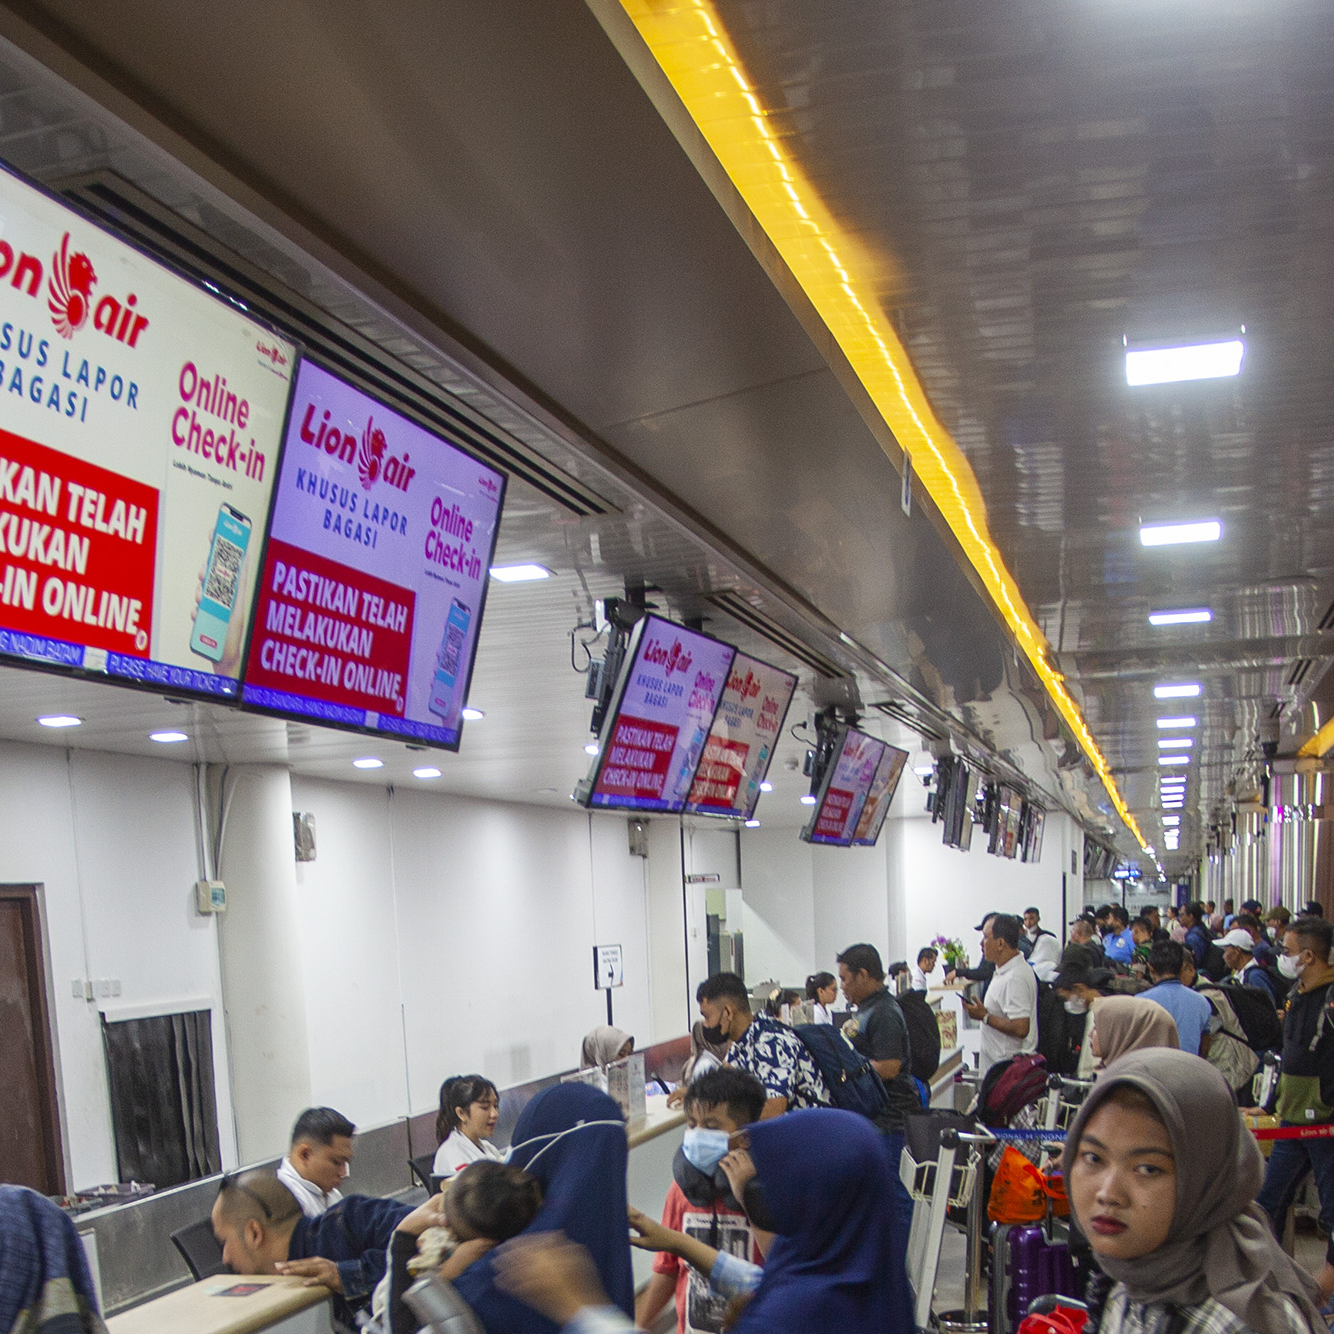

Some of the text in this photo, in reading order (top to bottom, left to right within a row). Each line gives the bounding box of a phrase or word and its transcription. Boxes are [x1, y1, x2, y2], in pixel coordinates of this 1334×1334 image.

[93, 294, 149, 348] air
[61, 350, 139, 411] LAPOR
[179, 361, 250, 429] Online
[171, 406, 265, 483] Check-in
[299, 404, 416, 494] Lion air
[67, 482, 147, 545] TELAH
[296, 468, 409, 538] KHUSUS LAPOR
[323, 509, 378, 550] BAGASI
[430, 495, 473, 542] Online
[424, 531, 481, 581] Check-in
[43, 577, 142, 634] ONLINE
[272, 560, 409, 635] PASTIKAN TELAH
[266, 603, 373, 659] MELAKUKAN
[643, 639, 693, 673] Lion air
[260, 640, 402, 702] CHECK-IN ONLINE
[636, 674, 685, 697] KHUSUS LAPOR
[609, 747, 656, 769] MELAKUKAN
[615, 725, 675, 752] PASTIKAN TELAH
[602, 768, 664, 791] CHECK-IN ONLINE
